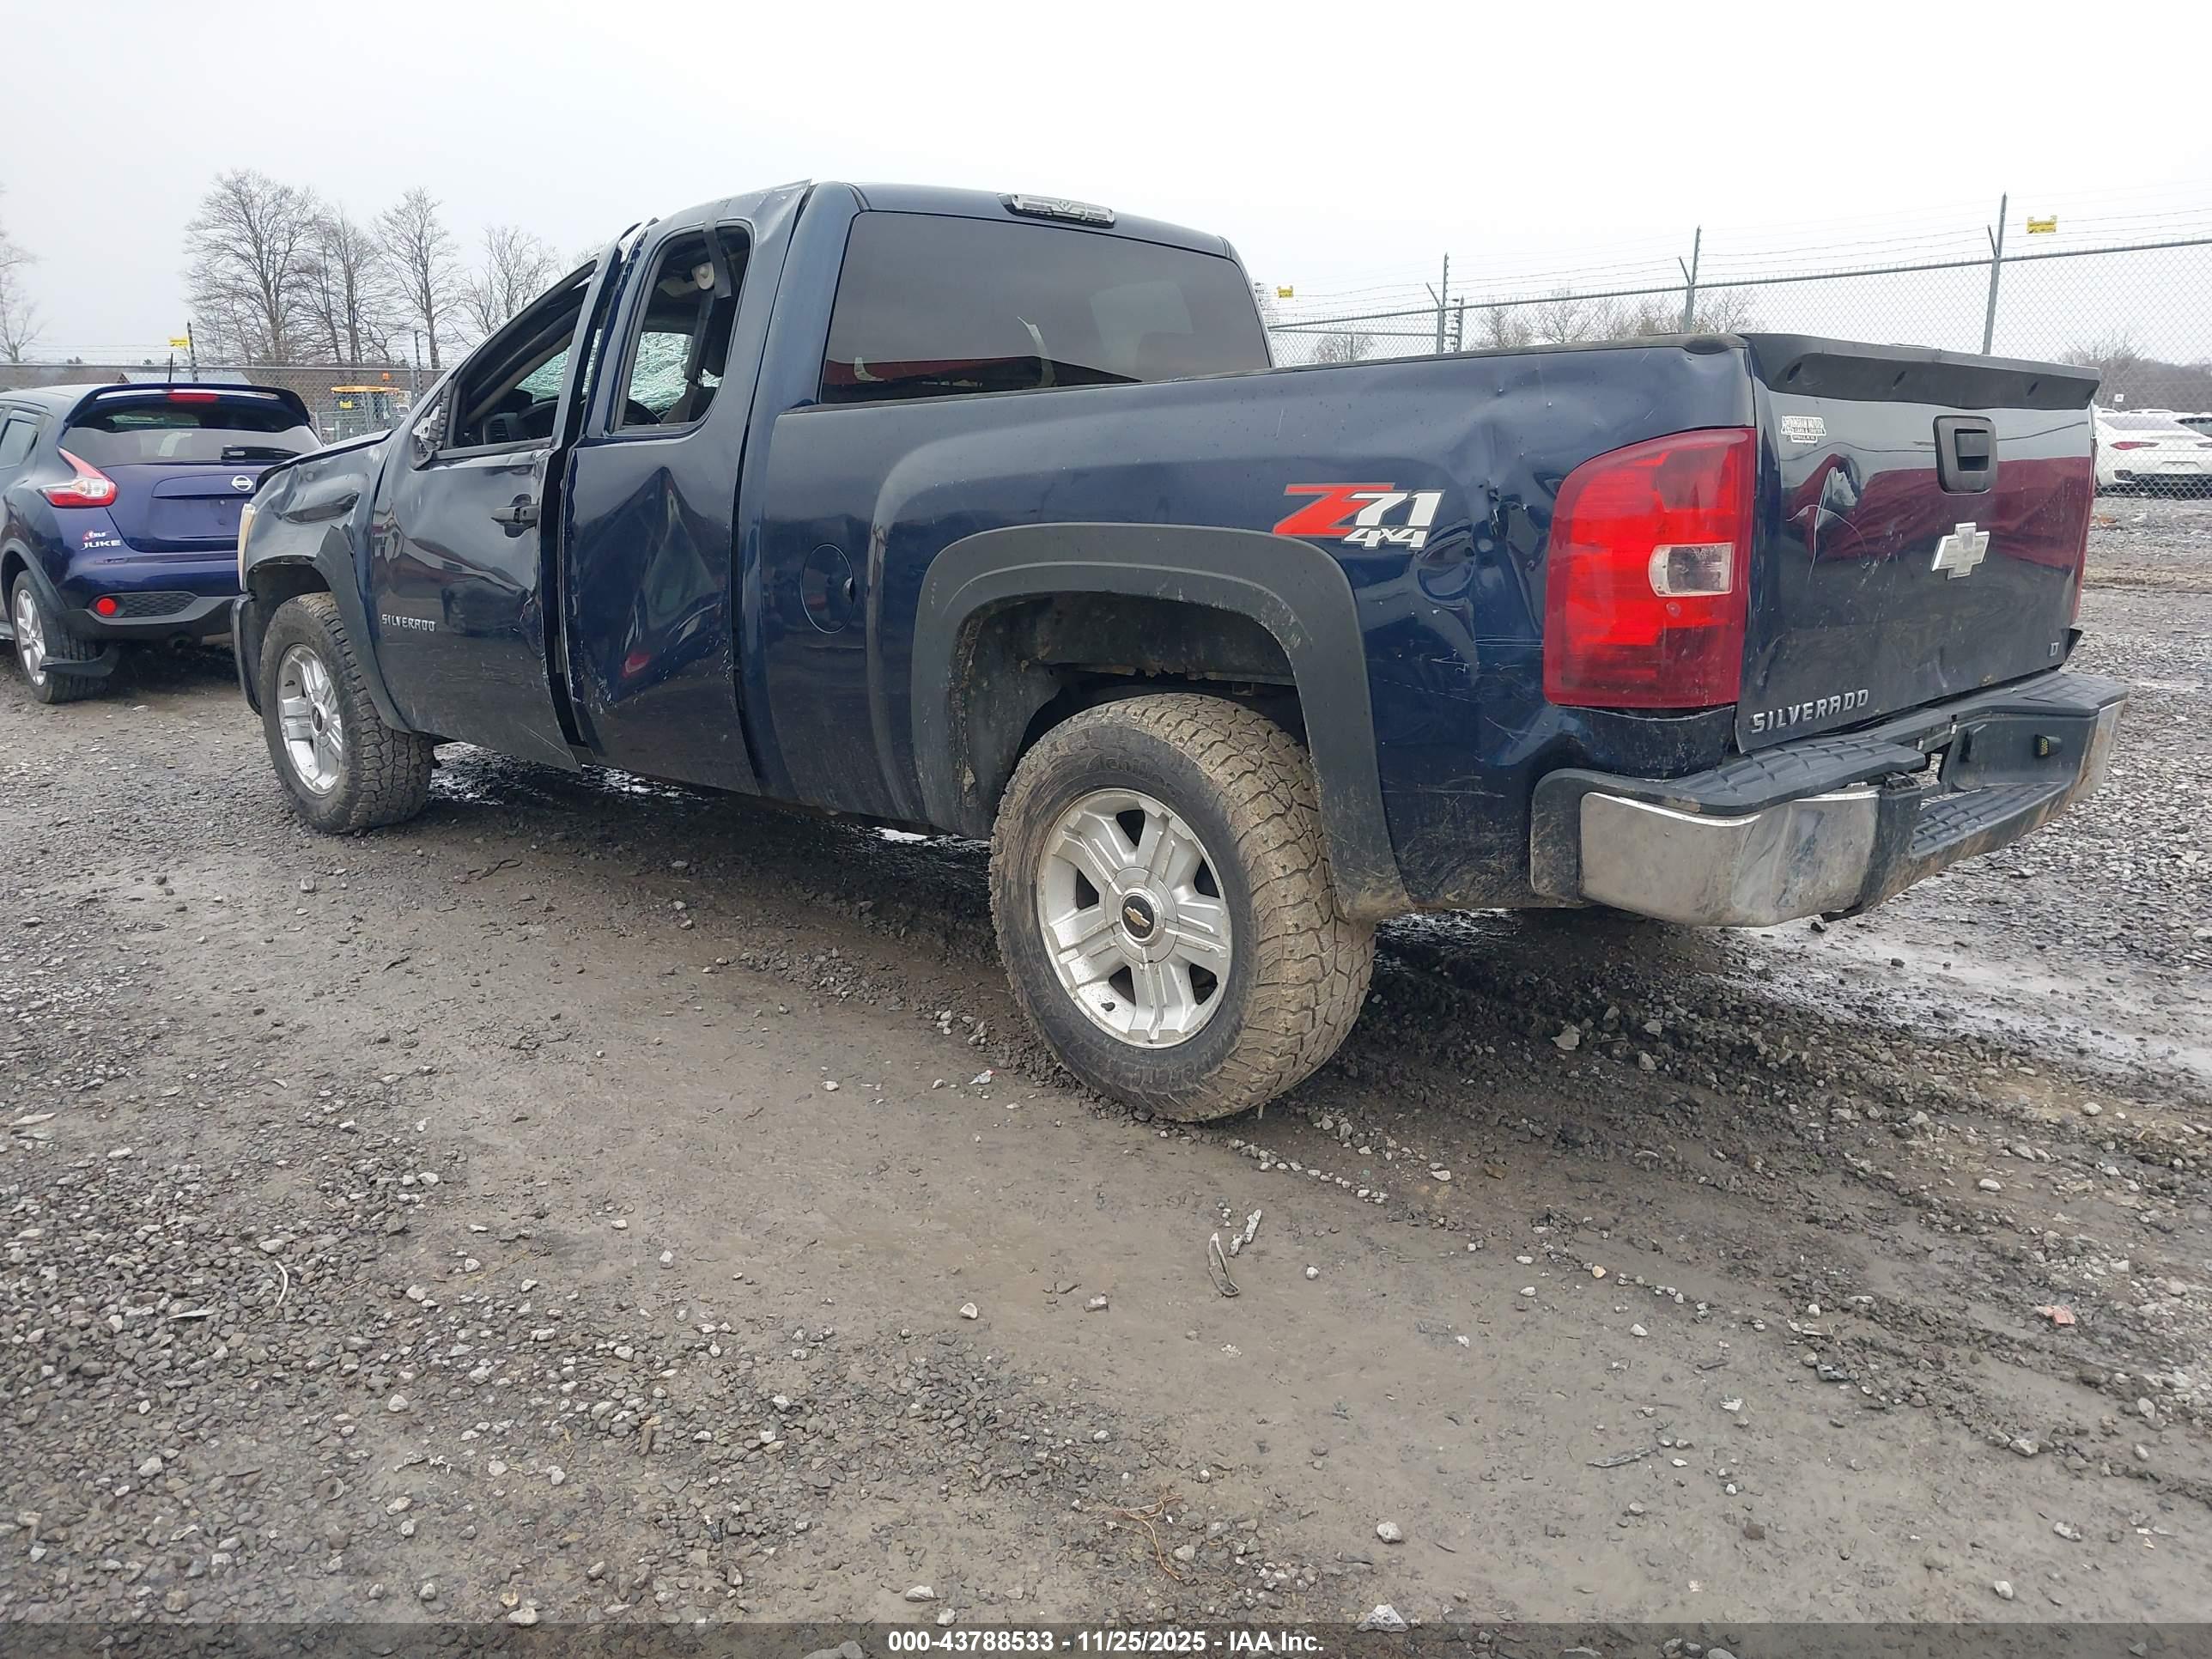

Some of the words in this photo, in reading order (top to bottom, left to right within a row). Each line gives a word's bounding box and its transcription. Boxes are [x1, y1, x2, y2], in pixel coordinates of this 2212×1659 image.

[1272, 483, 1446, 537] Z71
[80, 539, 121, 550] JUKE
[381, 614, 435, 632] SILVERADO
[1751, 689, 1869, 734] SILVERADO
